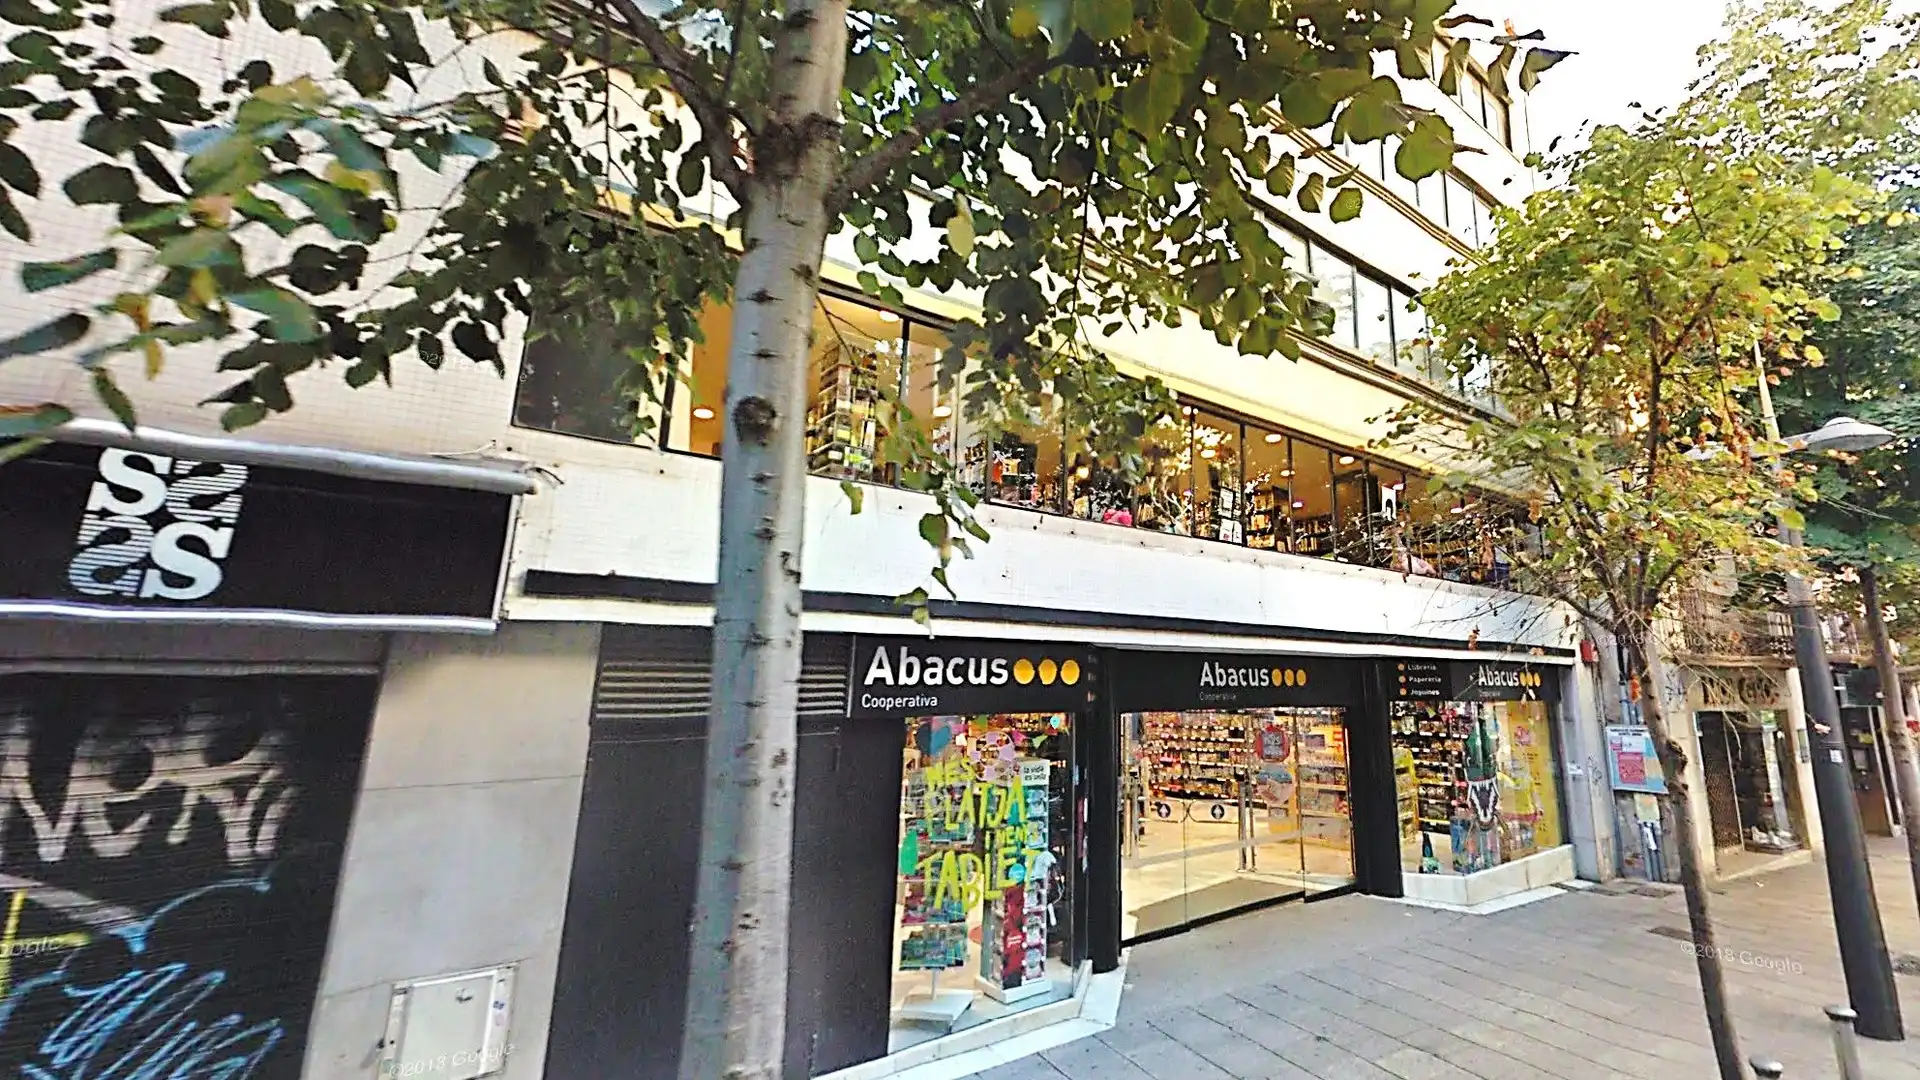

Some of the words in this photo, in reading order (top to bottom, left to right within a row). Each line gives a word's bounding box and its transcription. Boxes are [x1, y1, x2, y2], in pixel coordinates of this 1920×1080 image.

[863, 645, 1009, 686] Abacus
[1200, 661, 1270, 687] Abacus
[1478, 664, 1520, 687] Abacus
[861, 693, 938, 711] Cooperativa
[925, 776, 1028, 836] PLATJA
[915, 846, 1042, 912] TABLET
